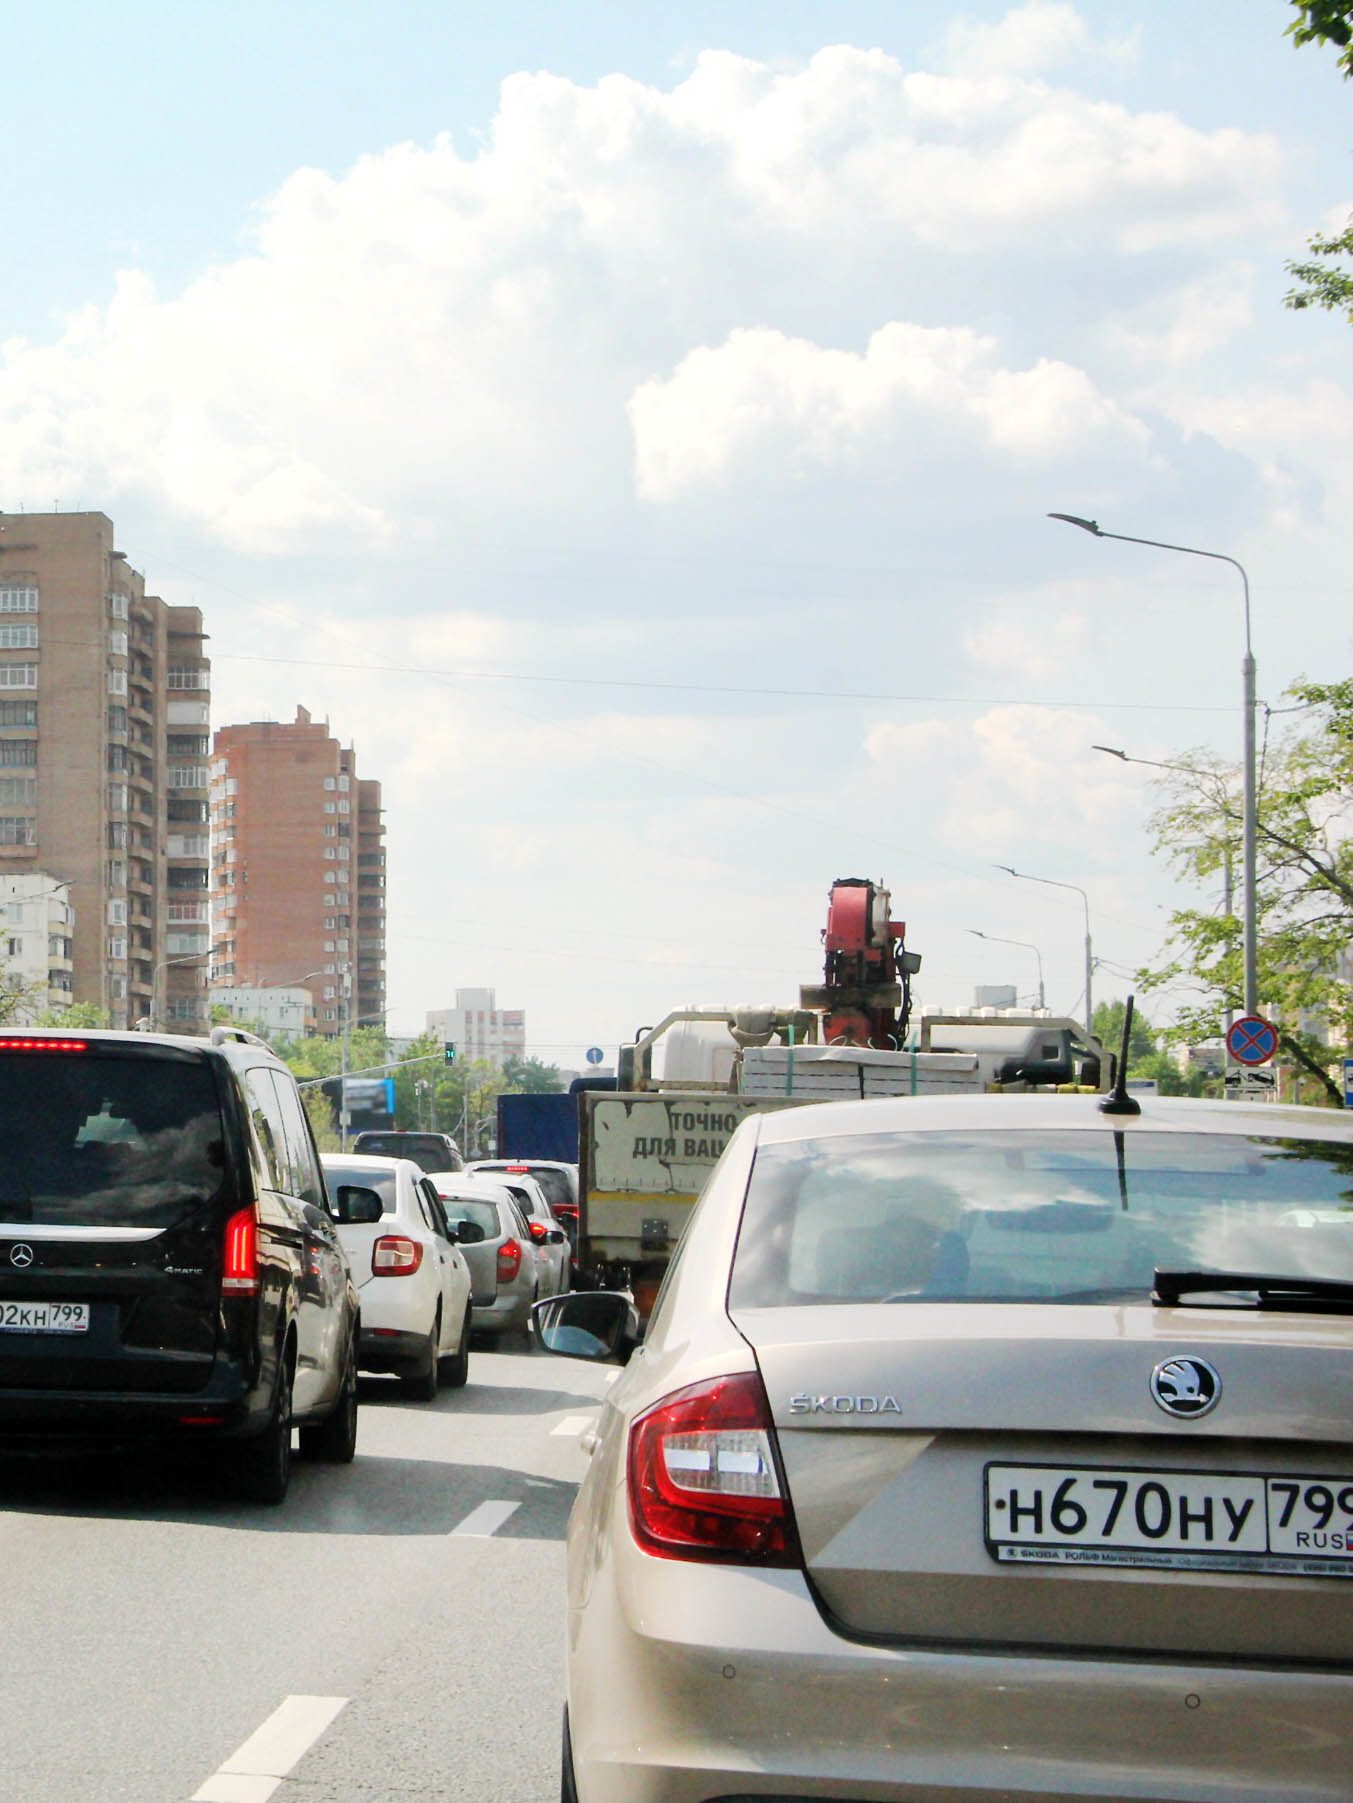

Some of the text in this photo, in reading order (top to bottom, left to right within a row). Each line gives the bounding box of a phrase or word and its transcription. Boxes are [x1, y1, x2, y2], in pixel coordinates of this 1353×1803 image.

[672, 1112, 738, 1133] ТОЧНО
[632, 1138, 677, 1159] ДЛЯ
[51, 1305, 83, 1322] 799
[1009, 1477, 1254, 1542] Н670НУ
[1296, 1532, 1344, 1550] RUS
